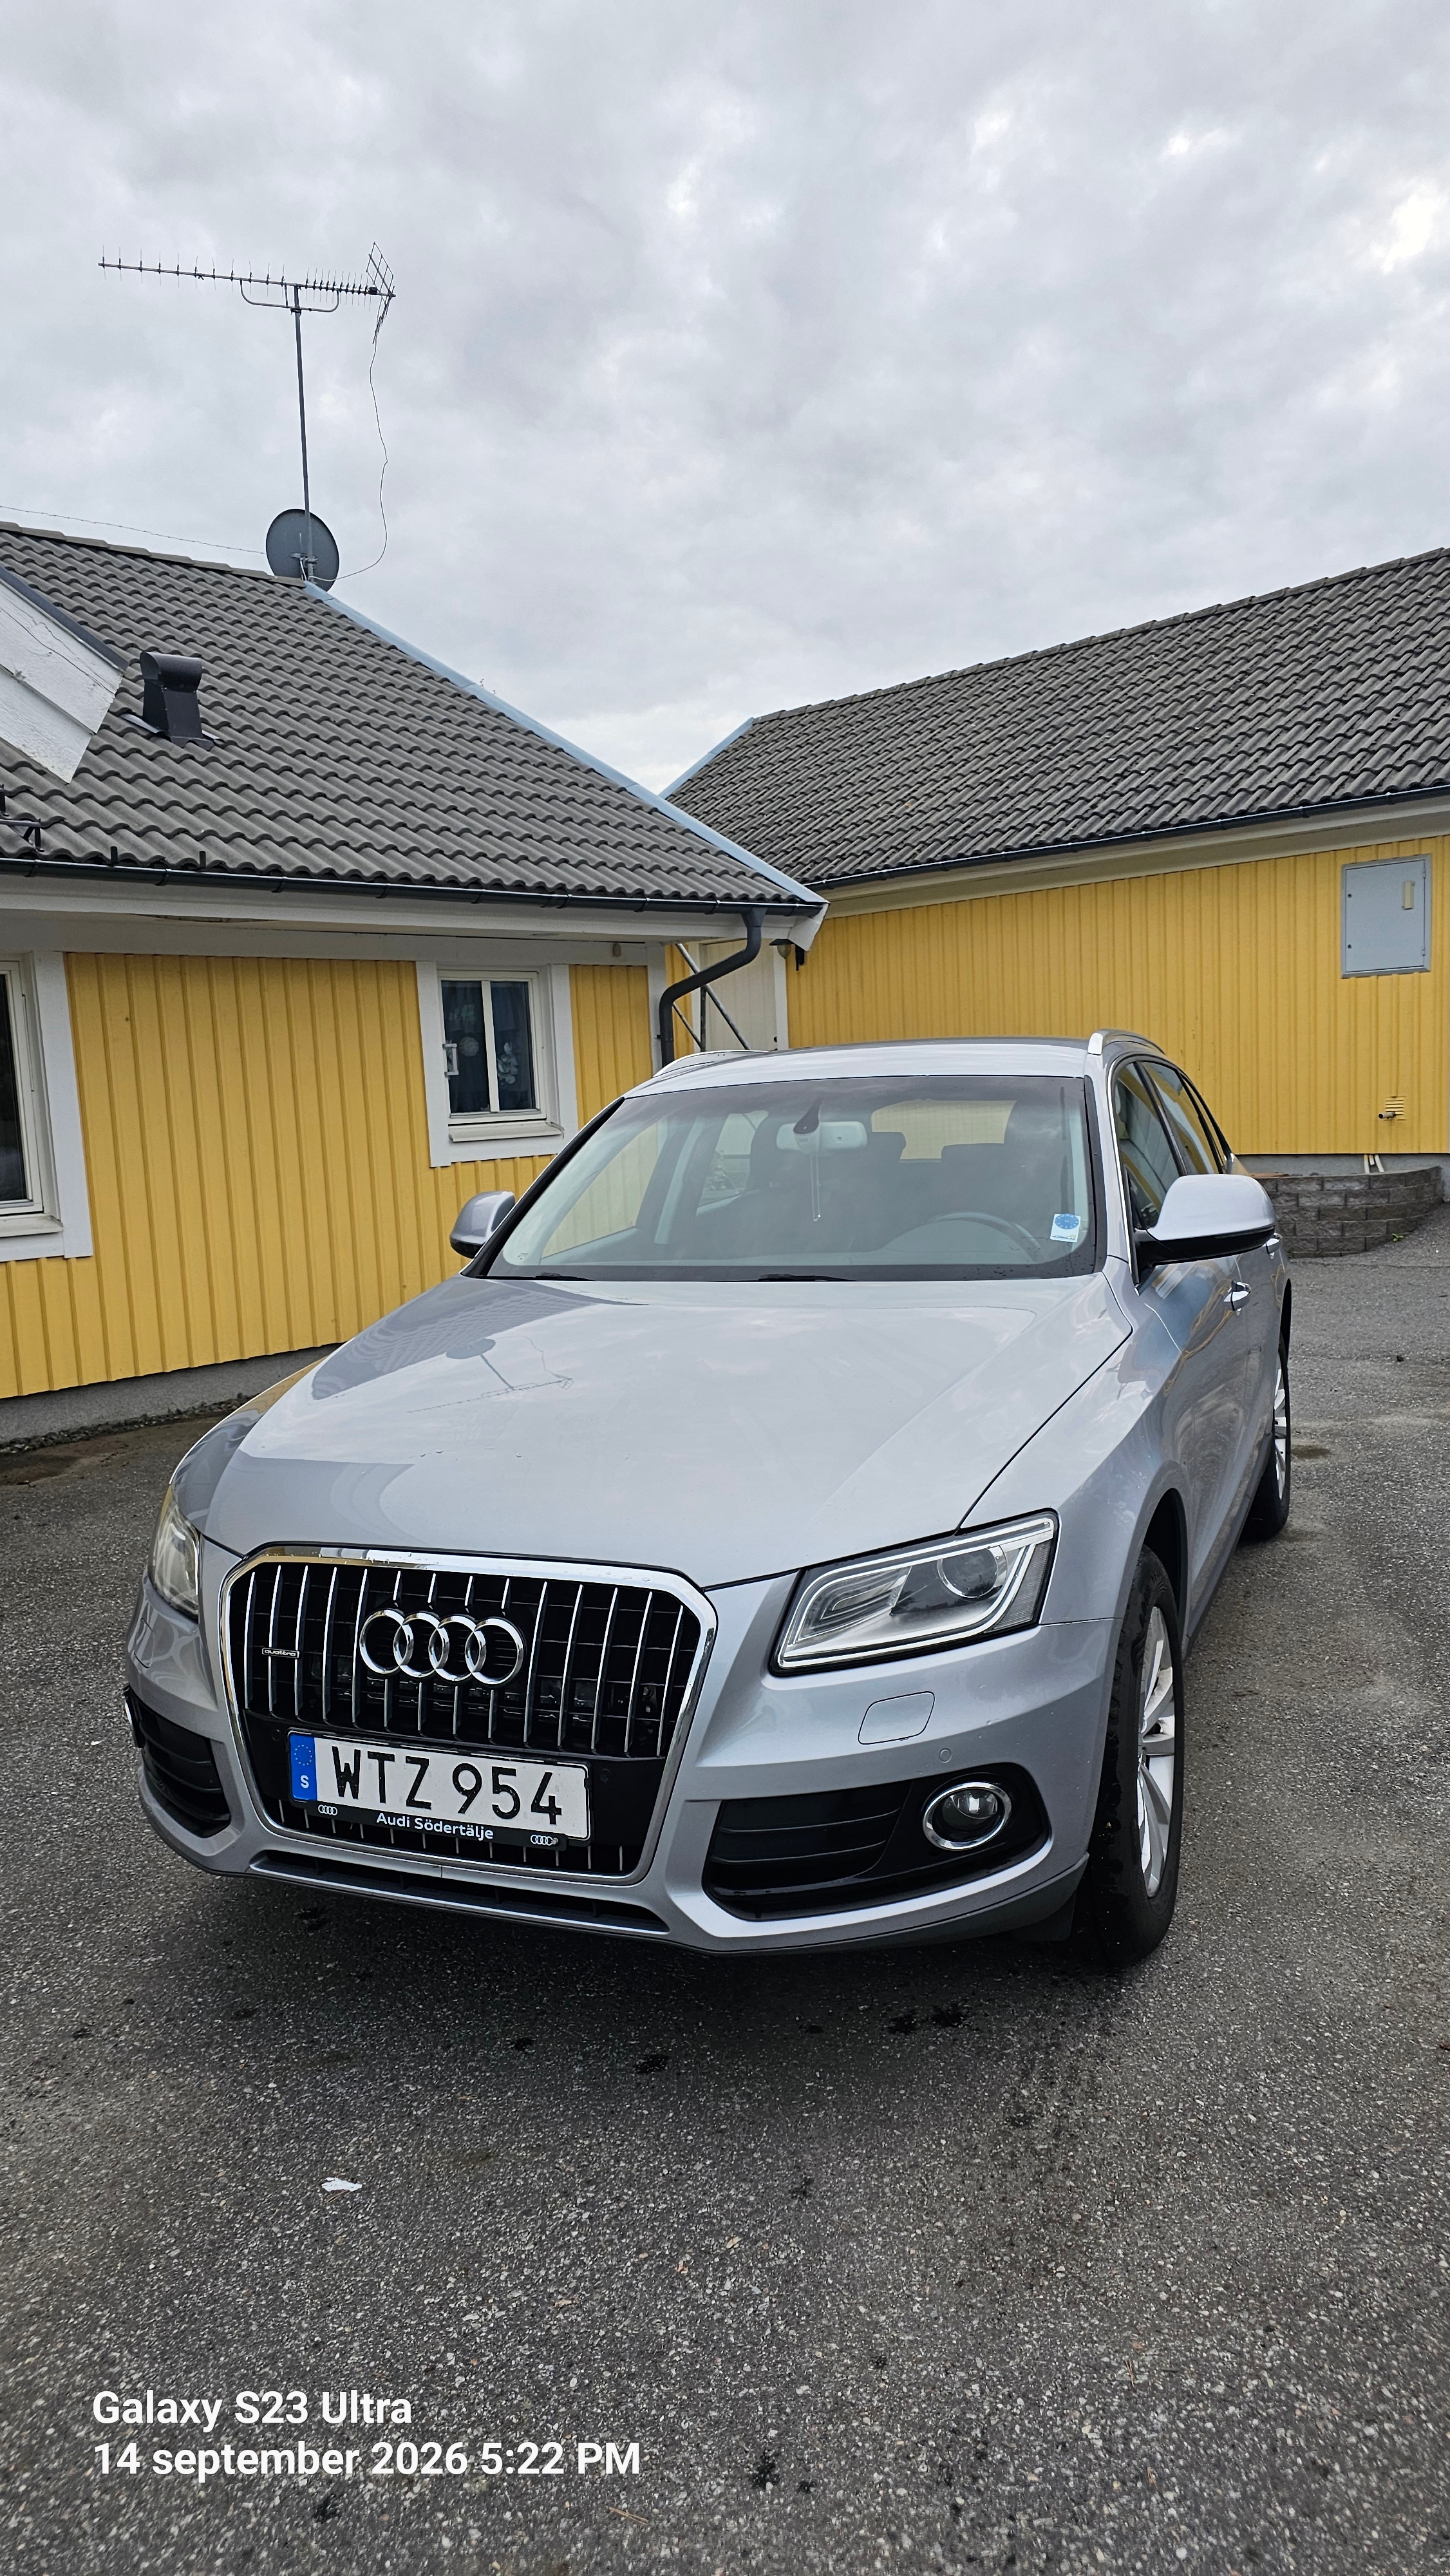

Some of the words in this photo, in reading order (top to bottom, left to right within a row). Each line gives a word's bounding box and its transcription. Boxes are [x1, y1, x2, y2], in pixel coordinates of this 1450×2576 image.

[300, 1775, 310, 1788] S
[332, 1746, 432, 1810] WTZ
[452, 1763, 562, 1825] 954
[376, 1812, 410, 1828] Audi
[414, 1817, 494, 1841] Södertälje
